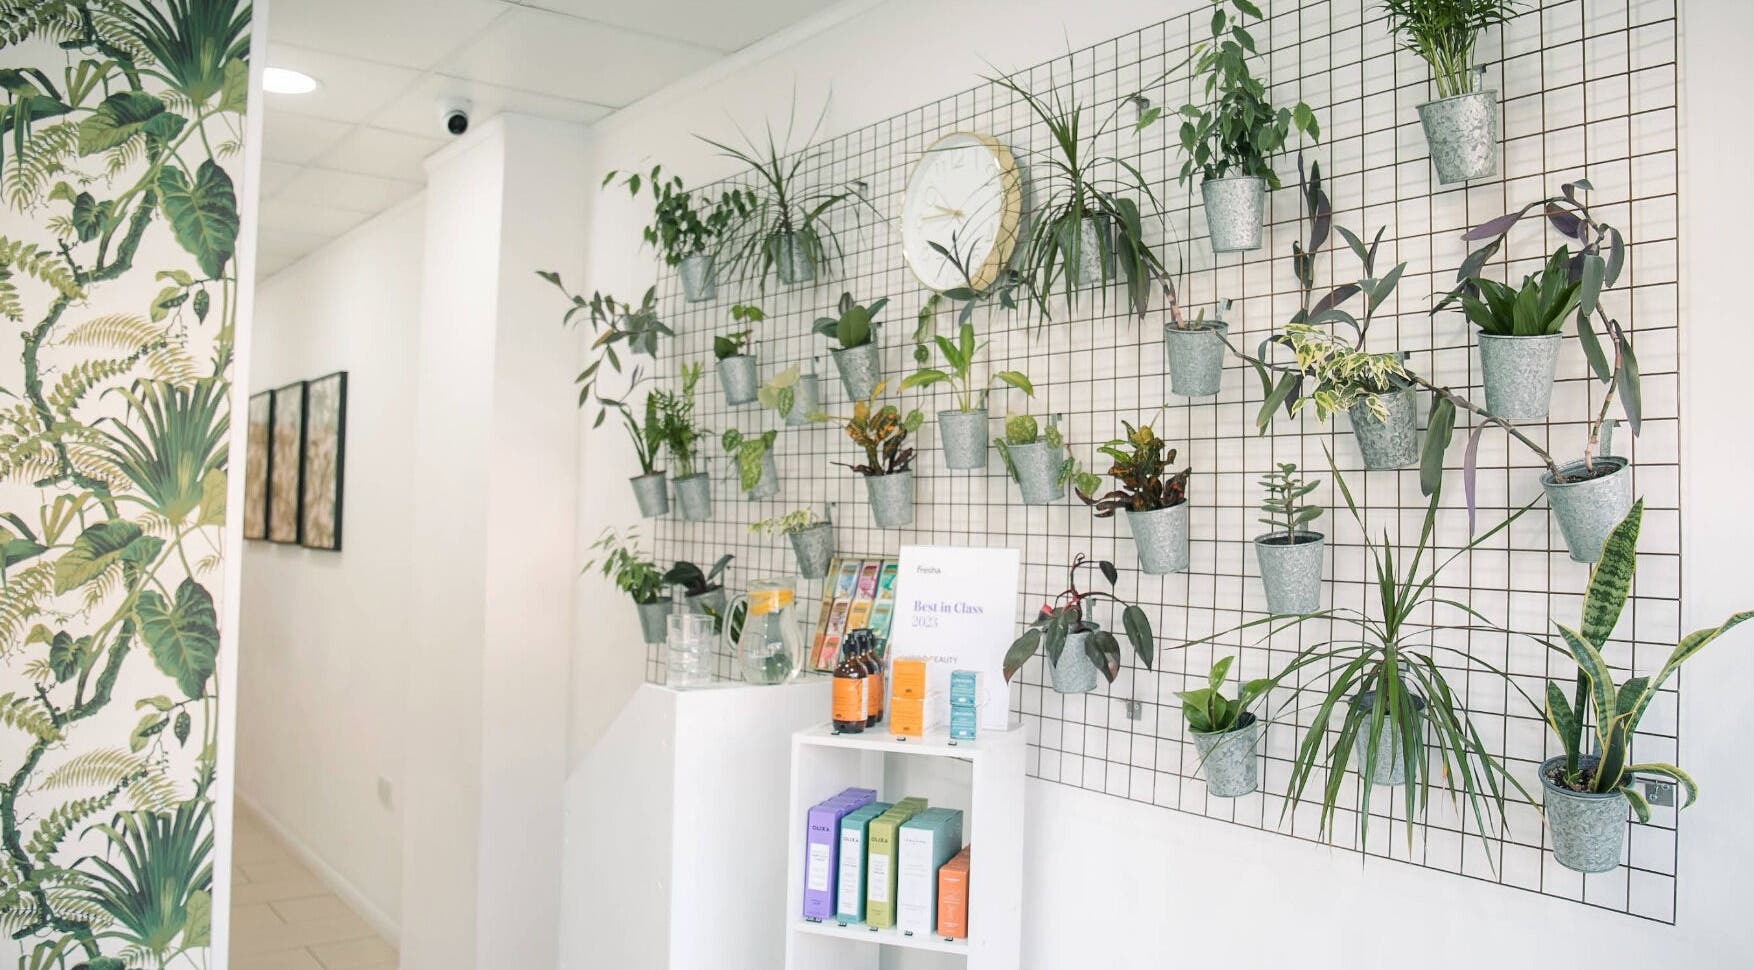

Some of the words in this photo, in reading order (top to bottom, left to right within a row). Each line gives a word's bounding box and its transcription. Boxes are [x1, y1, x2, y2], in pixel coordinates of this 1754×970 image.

[916, 565, 941, 574] fresha
[913, 600, 937, 612] Best
[940, 601, 951, 613] in
[954, 602, 984, 614] Class
[912, 615, 939, 628] 2023
